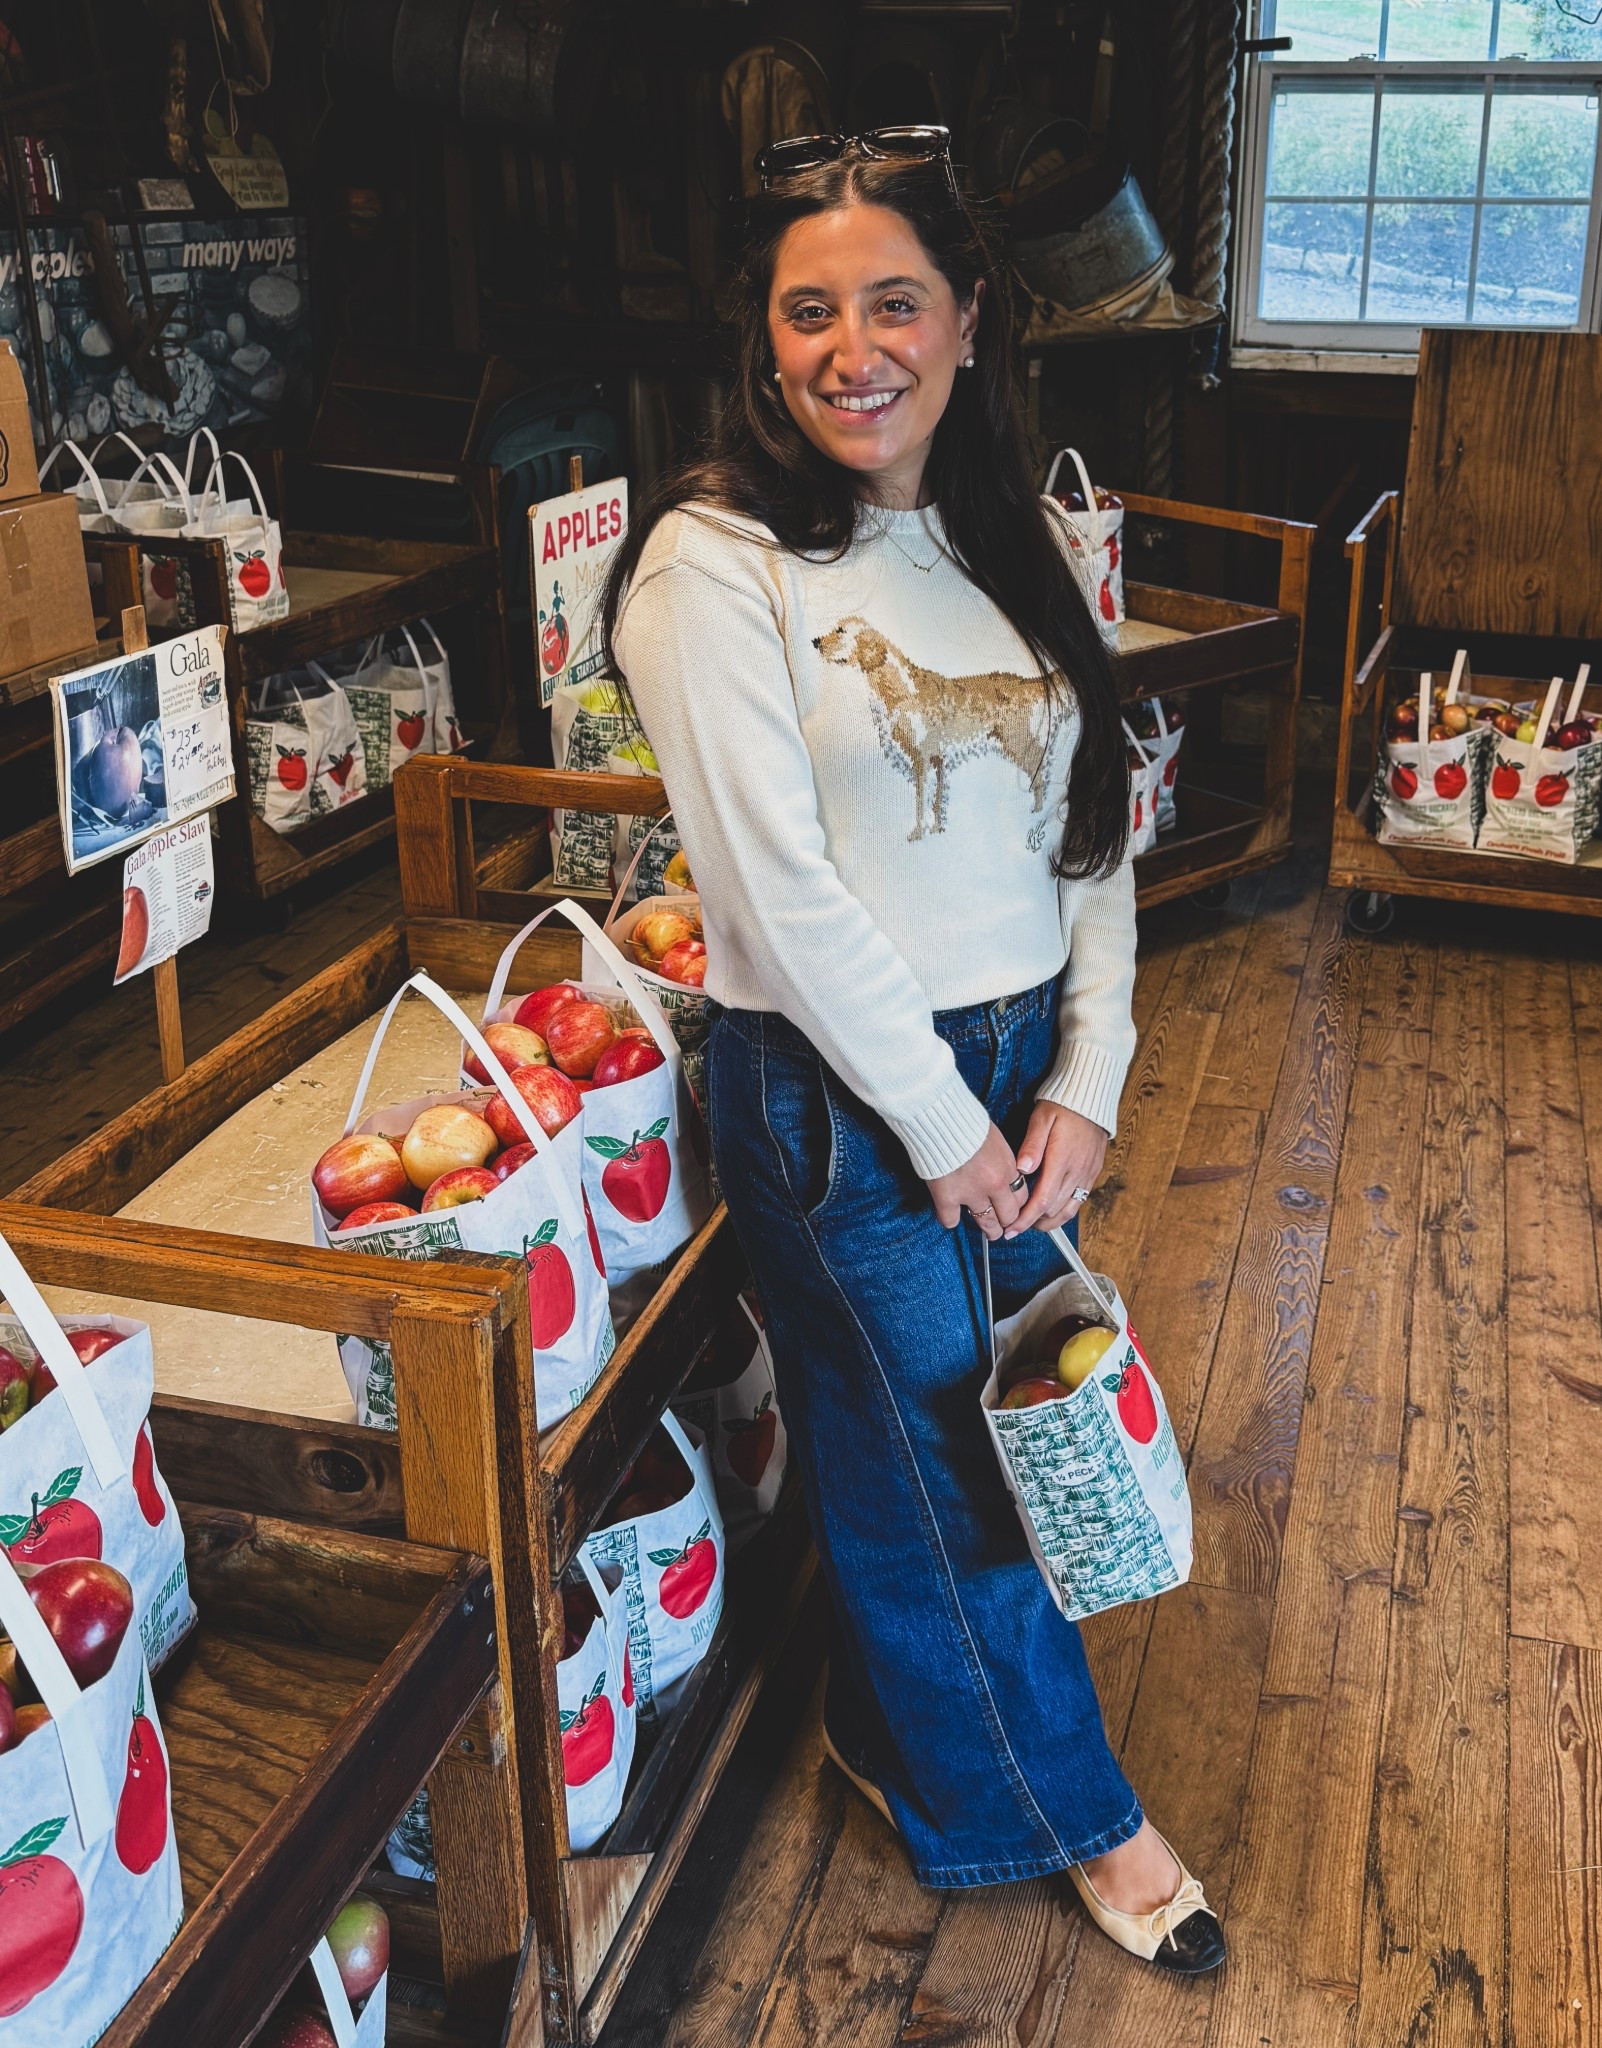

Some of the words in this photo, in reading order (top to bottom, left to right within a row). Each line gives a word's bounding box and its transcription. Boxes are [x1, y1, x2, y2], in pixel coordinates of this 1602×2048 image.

[182, 239, 244, 273] many
[248, 236, 297, 270] ways
[542, 497, 623, 565] APPLES
[170, 637, 211, 677] Gala
[127, 850, 146, 875] Gala
[146, 832, 176, 862] Apple
[179, 820, 206, 843] Slaw
[1068, 1465, 1096, 1480] PECK
